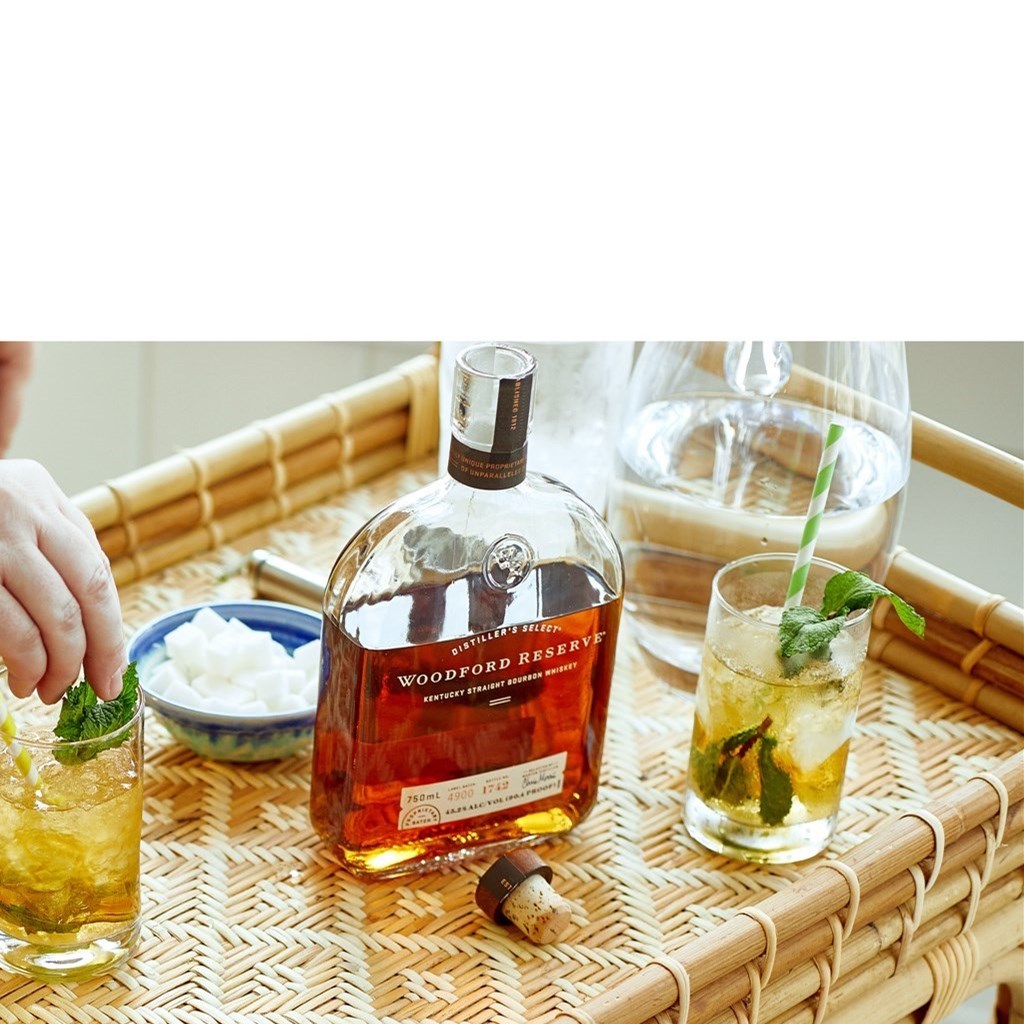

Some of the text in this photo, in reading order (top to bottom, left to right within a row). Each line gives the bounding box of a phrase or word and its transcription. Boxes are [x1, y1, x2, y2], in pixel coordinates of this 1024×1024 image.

[451, 624, 558, 656] DISTILLER'S SELECT
[397, 633, 603, 688] WOODFORD RESERVE
[423, 662, 578, 703] KENTUCKY STRAIGHT BOURBON WHISKEY
[447, 789, 474, 802] 4900
